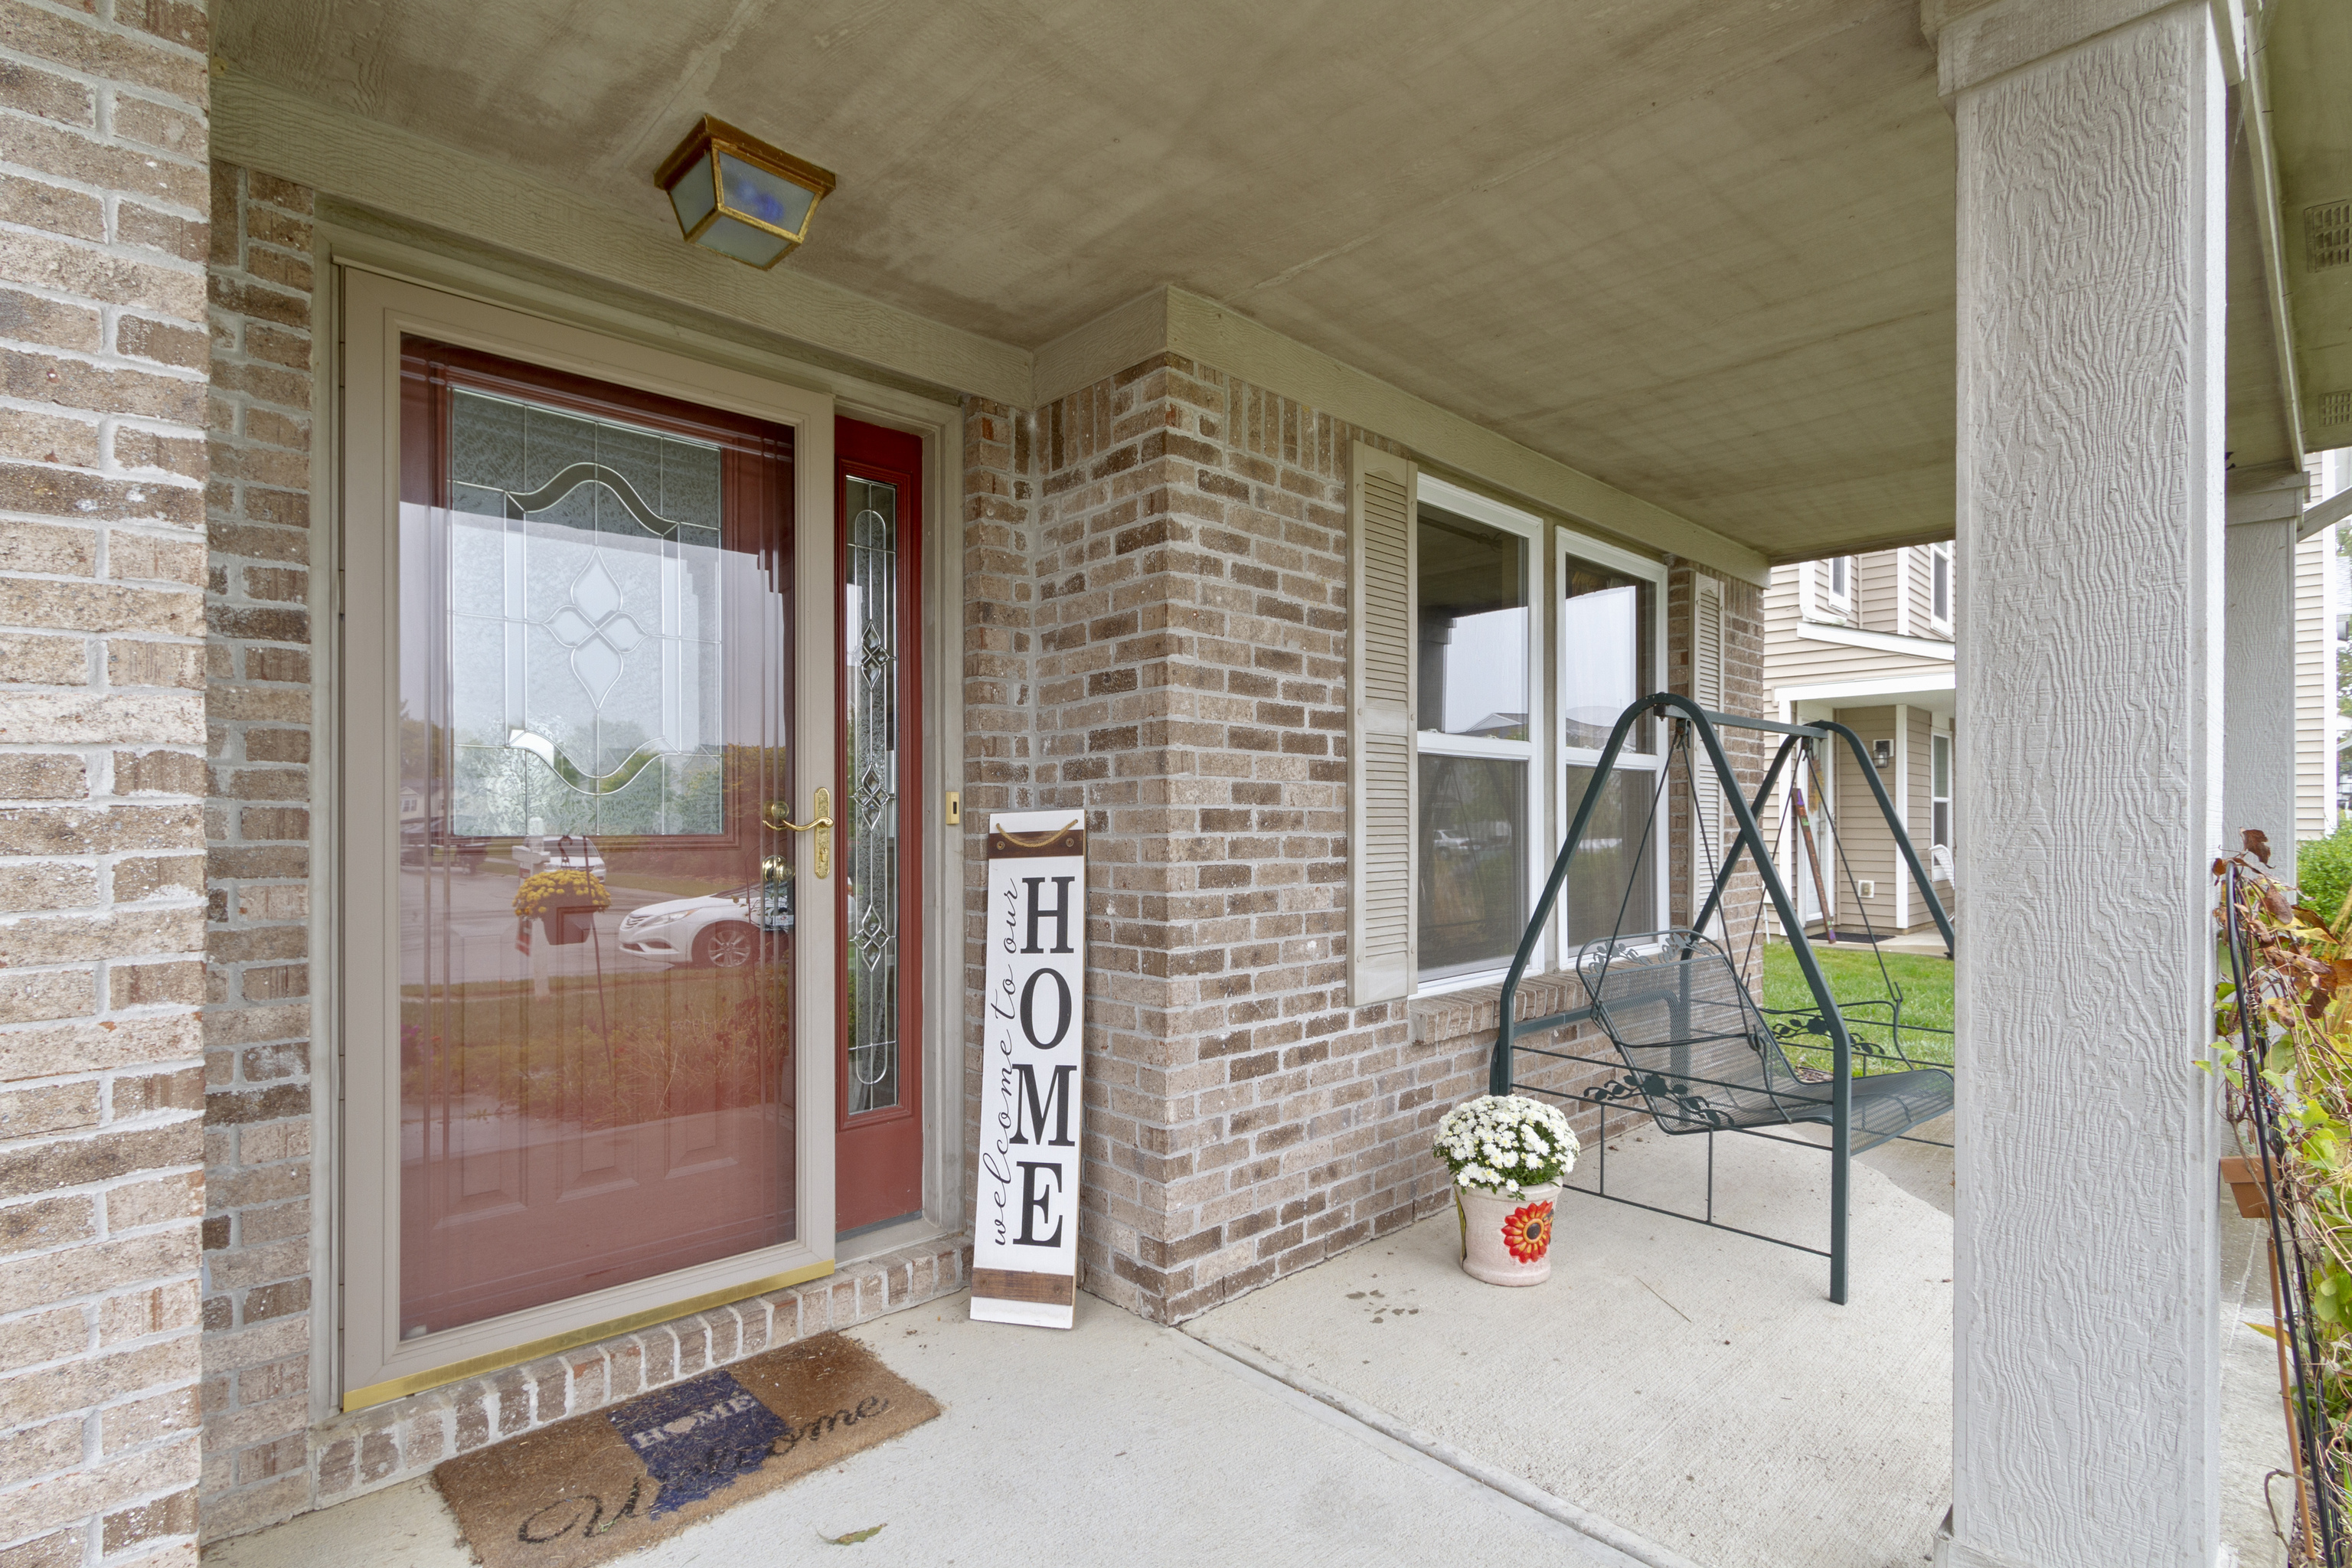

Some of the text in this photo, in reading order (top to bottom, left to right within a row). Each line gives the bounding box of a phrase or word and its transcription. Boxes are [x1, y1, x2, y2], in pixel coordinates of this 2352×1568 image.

[982, 877, 1018, 1246] welcome to our
[1009, 876, 1077, 1249] HOME
